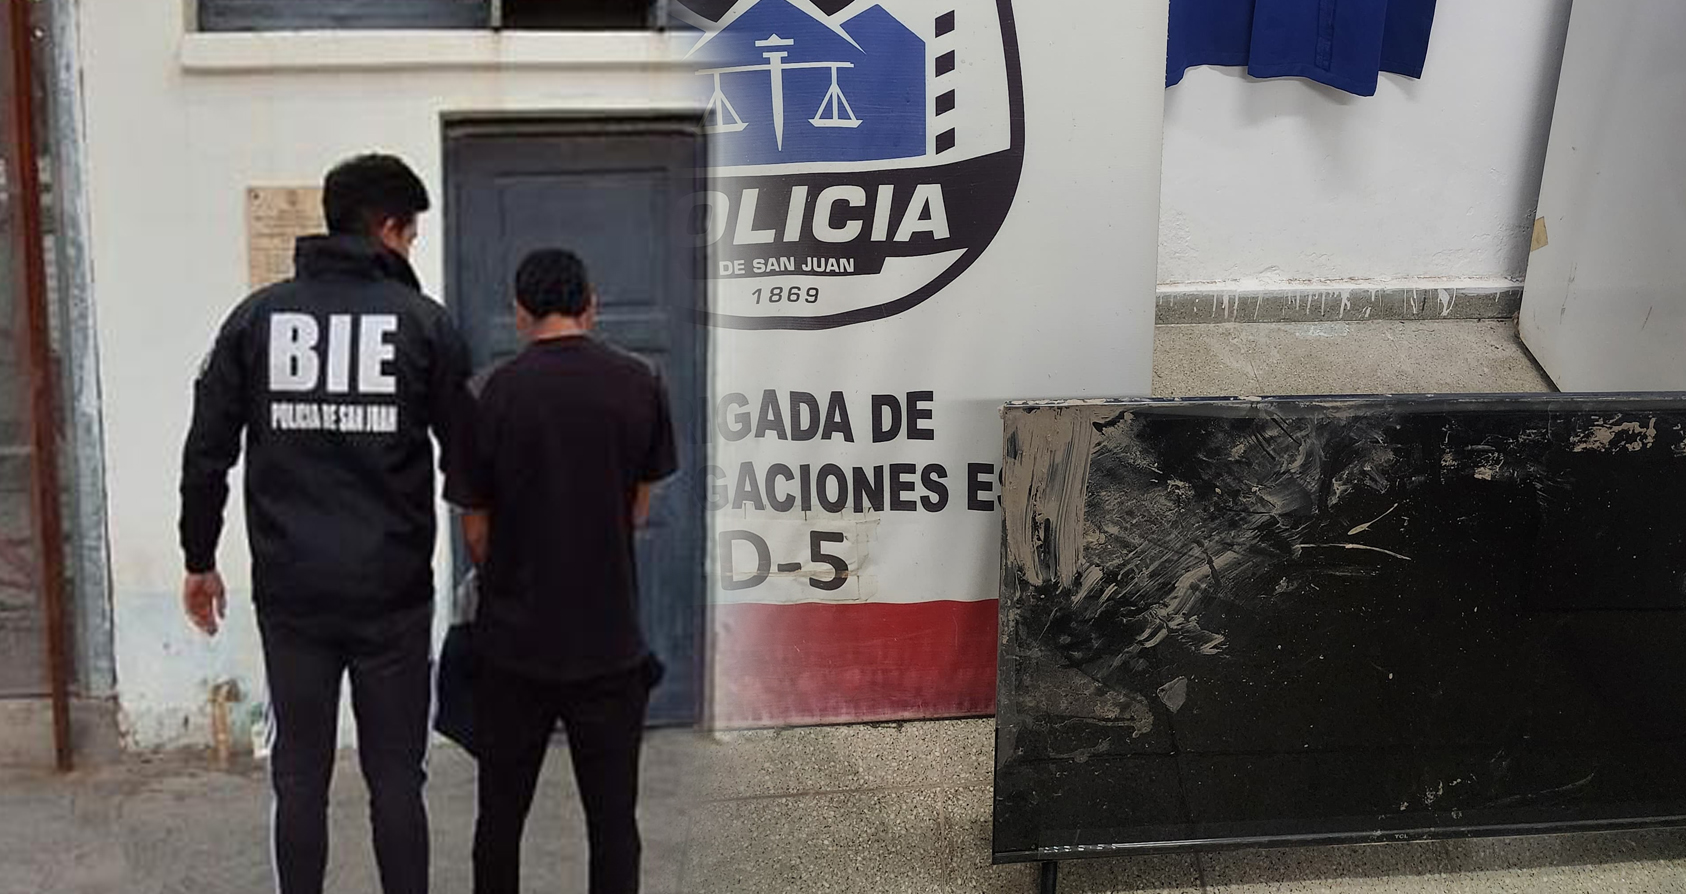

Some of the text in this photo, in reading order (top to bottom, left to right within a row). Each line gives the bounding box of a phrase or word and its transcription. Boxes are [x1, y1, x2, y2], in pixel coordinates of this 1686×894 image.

[719, 257, 855, 276] DE SAN JUAN
[751, 286, 819, 305] 1869
[269, 312, 399, 394] BIE
[271, 402, 398, 433] POLICIA DE SAN JUAN
[701, 389, 935, 443] GADA DE
[967, 462, 1003, 511] E
[718, 530, 849, 591] D-5
